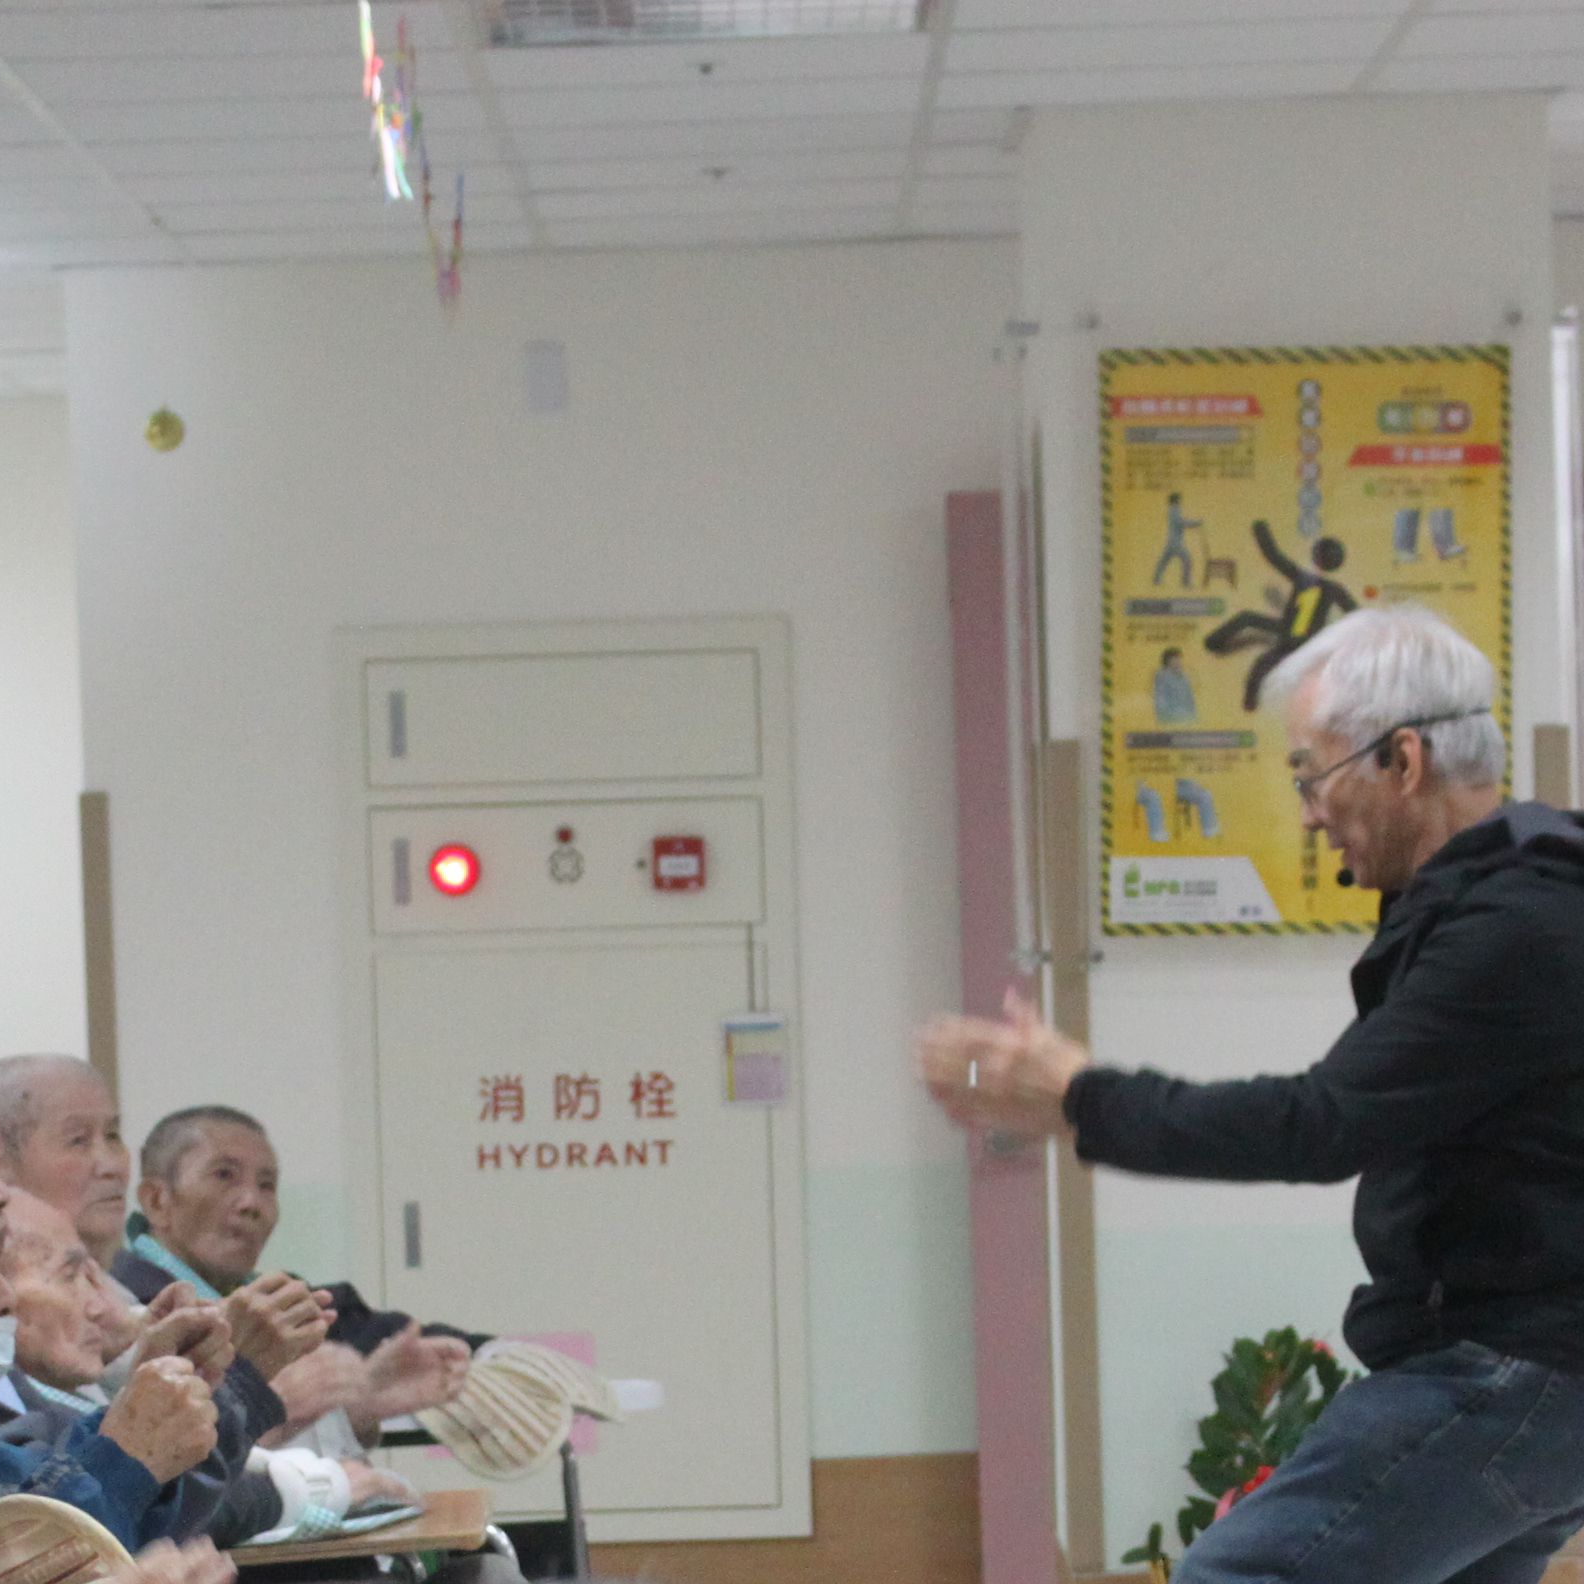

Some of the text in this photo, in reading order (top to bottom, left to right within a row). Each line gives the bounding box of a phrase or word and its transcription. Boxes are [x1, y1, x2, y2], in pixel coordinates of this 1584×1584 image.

[479, 1071, 677, 1122] 消防栓
[477, 1140, 673, 1170] HYDRANT
